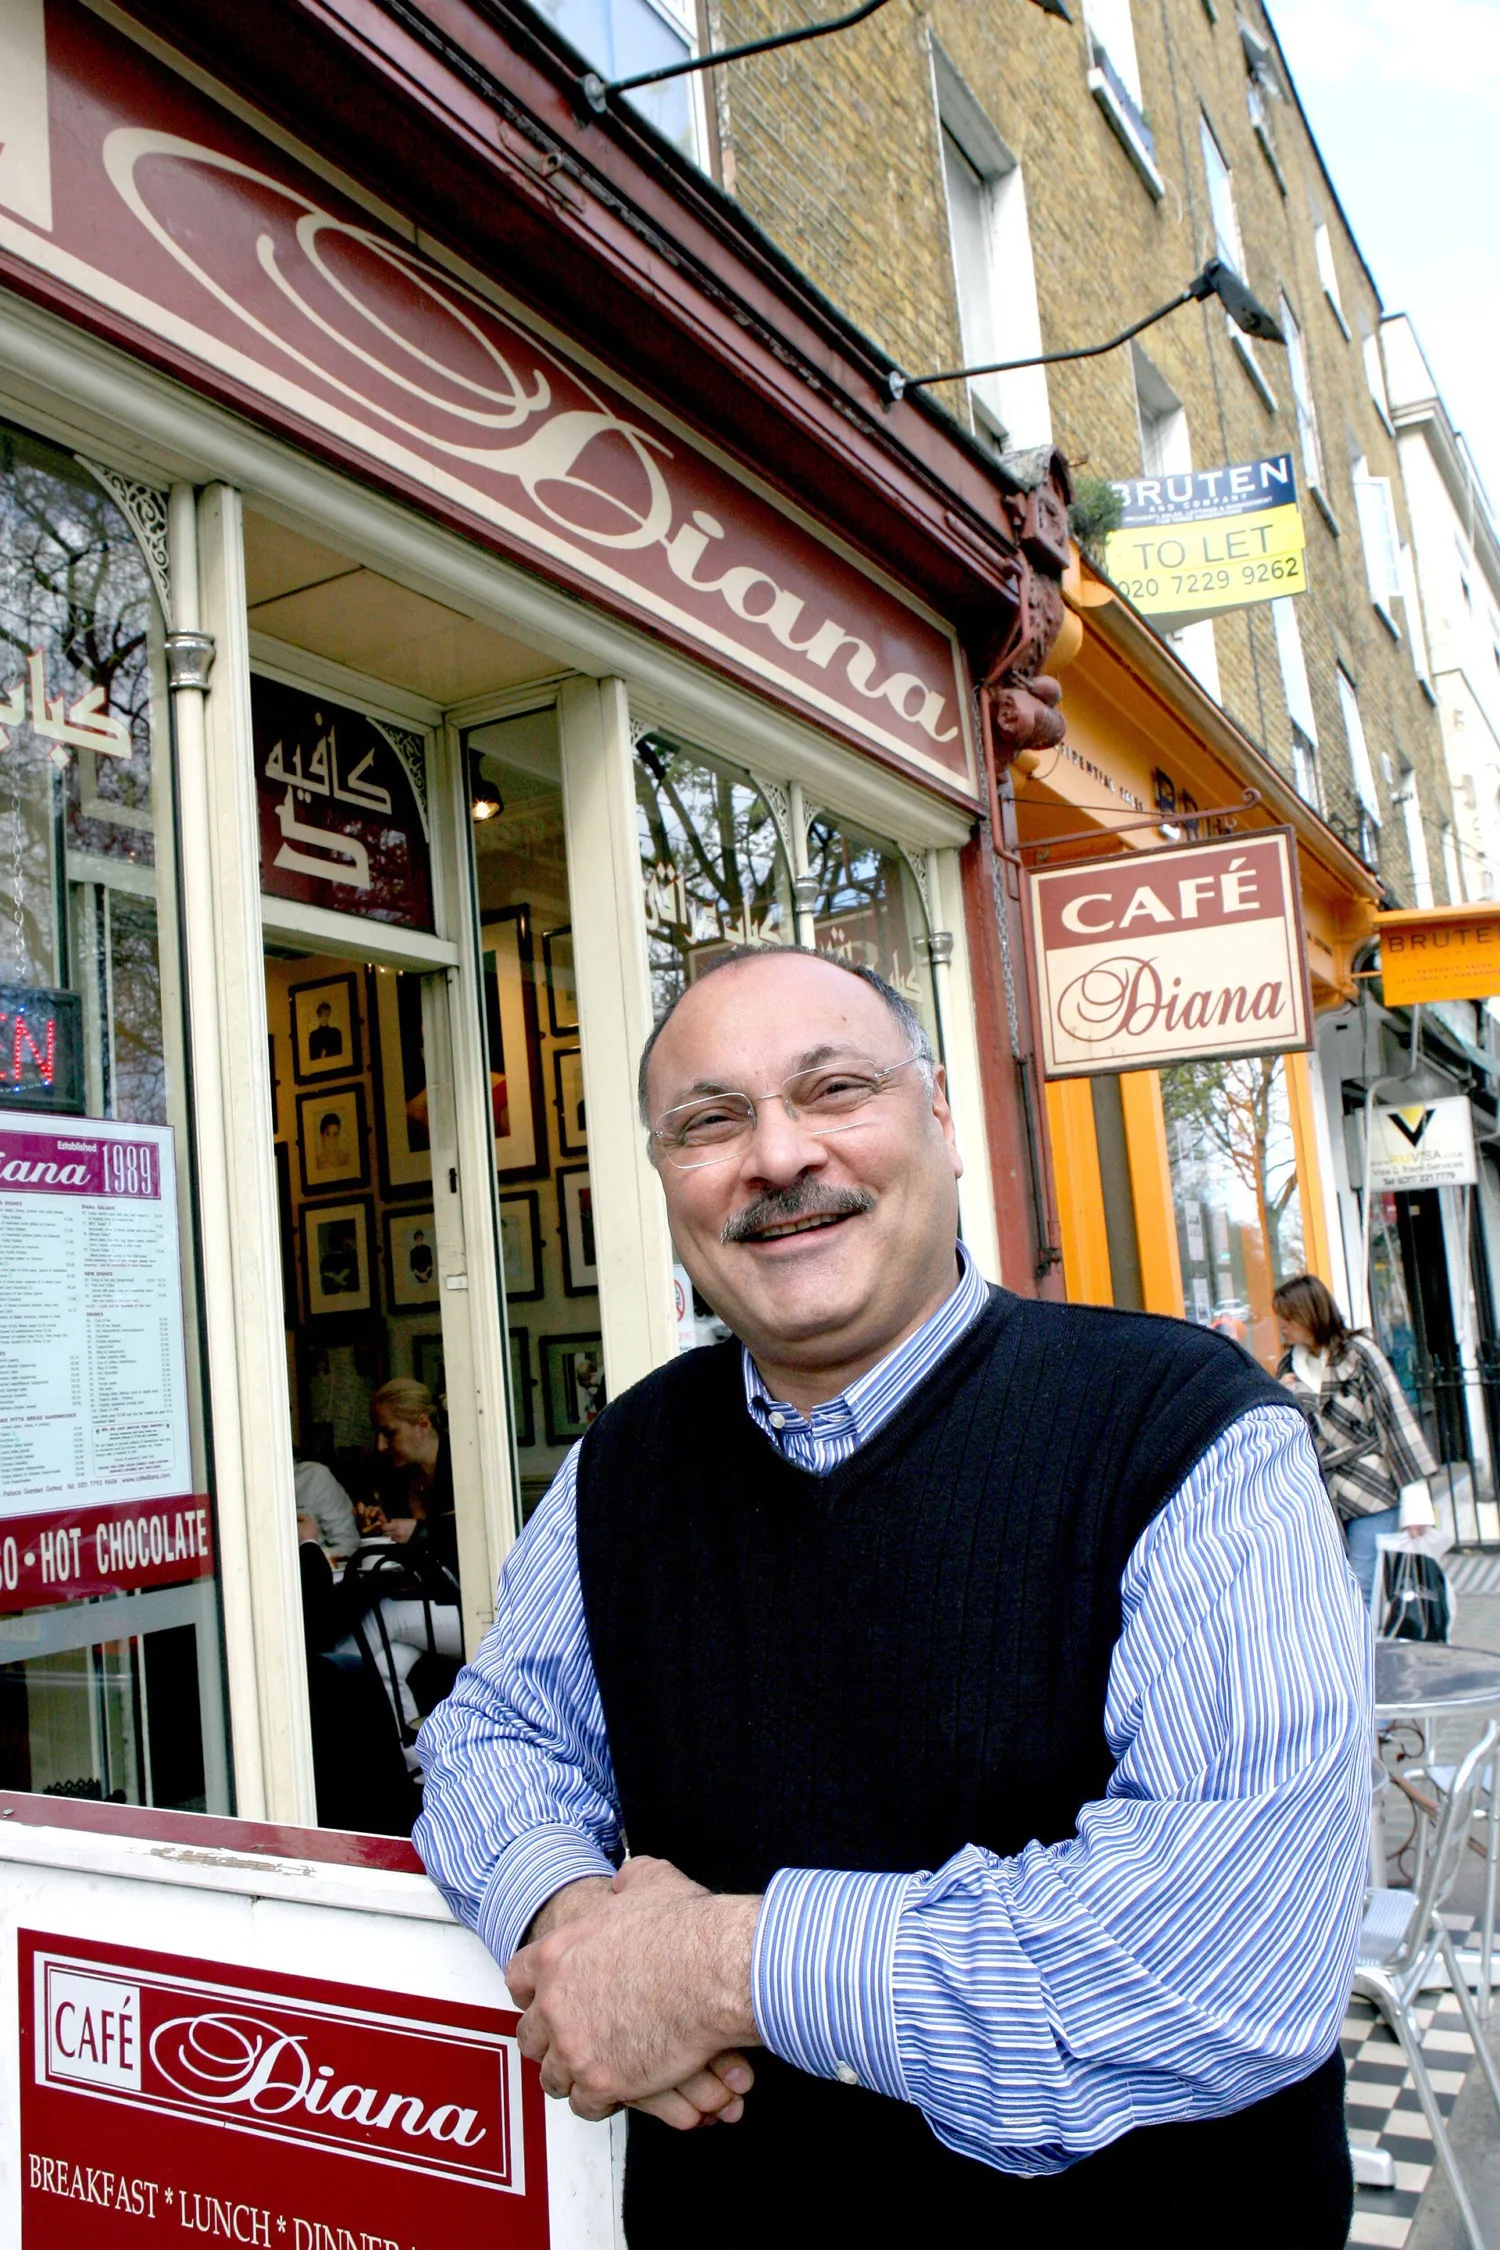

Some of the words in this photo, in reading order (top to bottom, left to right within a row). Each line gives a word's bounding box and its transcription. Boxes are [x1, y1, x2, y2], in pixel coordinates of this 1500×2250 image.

[102, 127, 958, 743] Diana
[1111, 458, 1289, 507] BRUTEN
[1117, 578, 1159, 598] 020
[1171, 570, 1230, 594] 7229
[1242, 557, 1299, 585] 9262
[1133, 540, 1186, 570] TO
[1202, 524, 1274, 563] LET
[1061, 857, 1261, 934] CAFÉ
[1388, 926, 1500, 953] BRUTE
[1057, 956, 1287, 1043] Diana
[57, 1140, 97, 1153] Established
[102, 1143, 152, 1195] 1989
[40, 1527, 82, 1583] HOT
[96, 1509, 209, 1574] CHOCOLATE
[55, 1996, 134, 2071] CAFÉ
[149, 2013, 487, 2148] Diana
[28, 2153, 159, 2219] BREAKFAST
[179, 2190, 271, 2248] LUNCH
